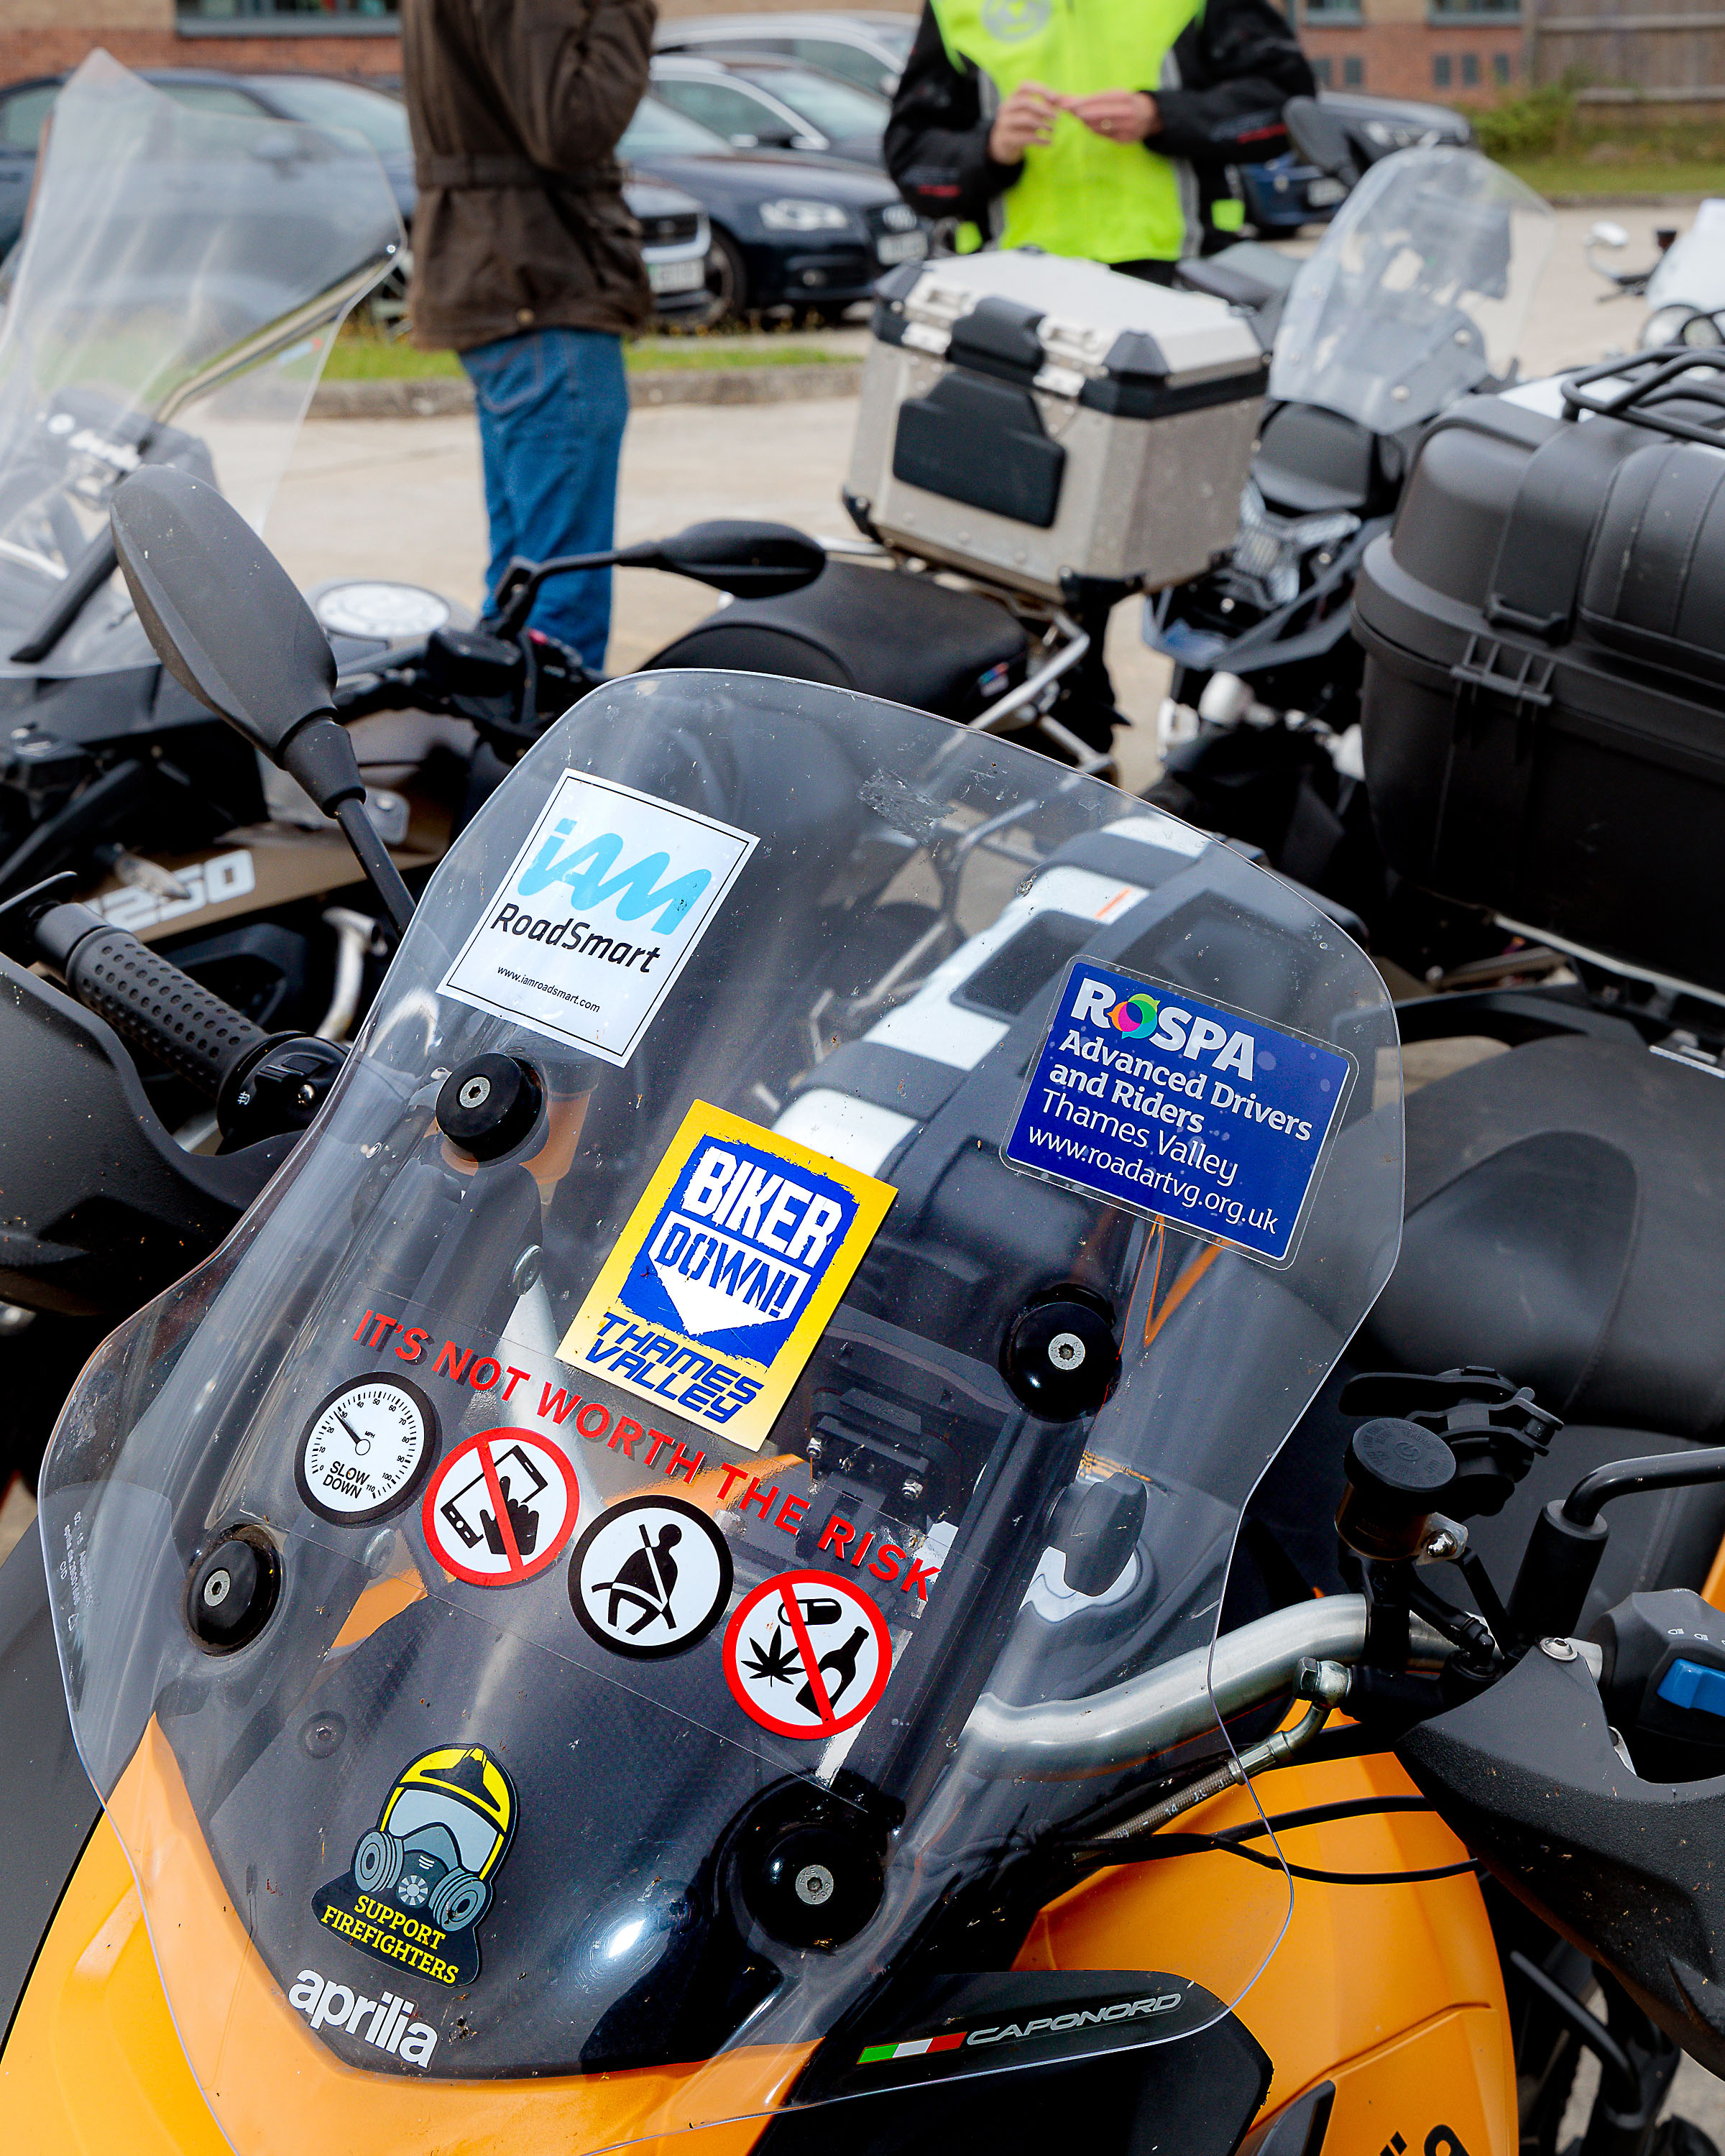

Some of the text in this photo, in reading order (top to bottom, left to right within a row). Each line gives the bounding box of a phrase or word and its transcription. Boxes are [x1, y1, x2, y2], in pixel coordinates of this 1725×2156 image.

[490, 903, 661, 973] RoadSmart
[497, 965, 600, 1013] www.iamroadsmart.com
[1049, 1062, 1205, 1134] and Riders
[1059, 1029, 1312, 1142] Advanced Drivers
[1042, 1088, 1239, 1188] Thames Valley
[681, 1146, 843, 1268] BIKER
[1029, 1126, 1279, 1235] www.roadartvg.org.uk
[585, 1339, 743, 1424] VALLEY
[597, 1312, 764, 1405] THAMES
[351, 1309, 942, 1602] IT'S NOT WORTH THE RISK
[364, 1430, 376, 1439] MPH
[323, 1473, 362, 1499] DOWN
[329, 1460, 370, 1485] SLOW
[366, 1484, 376, 1493] 110
[382, 1472, 392, 1481] 100
[321, 1905, 459, 1985] FIREFIGHTERS
[354, 1895, 446, 1950] SUPPORT
[288, 1968, 438, 2069] aprilia
[967, 1993, 1182, 2046] CAPONORD
